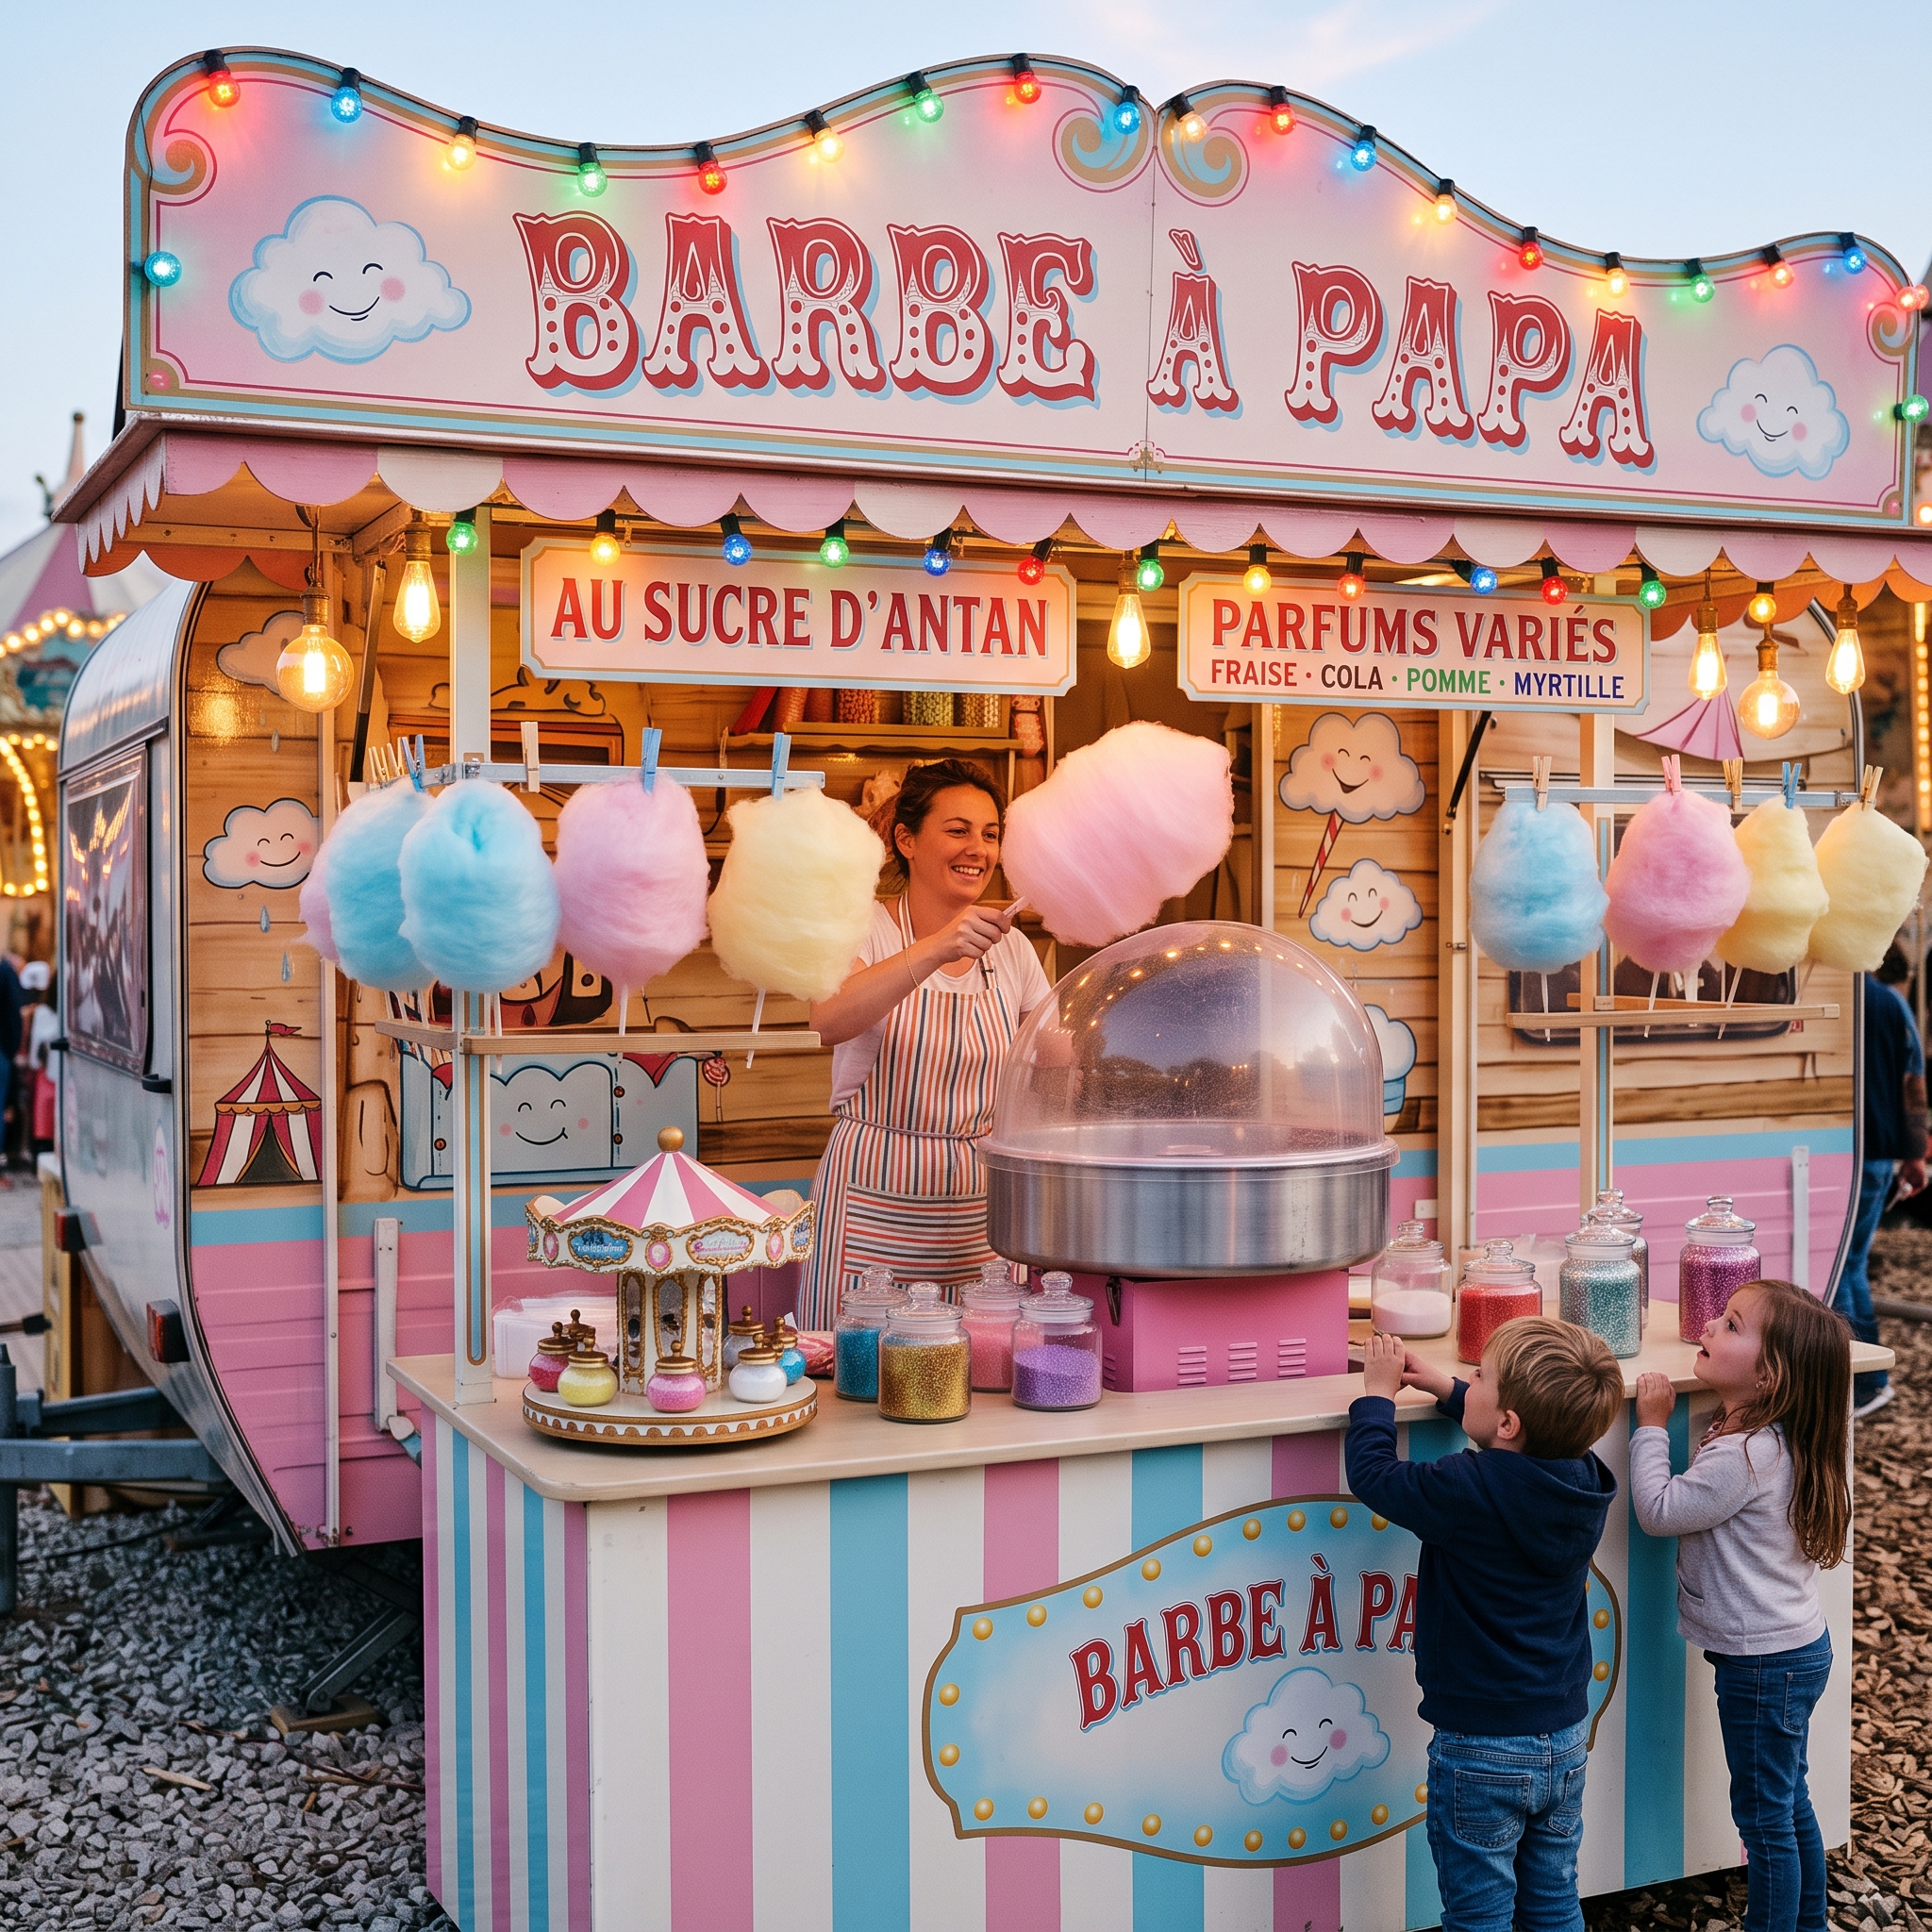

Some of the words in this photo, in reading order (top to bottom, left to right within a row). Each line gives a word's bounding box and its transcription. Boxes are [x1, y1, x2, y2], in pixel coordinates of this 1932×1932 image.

[512, 209, 1100, 408] BARBE
[1146, 228, 1242, 418] À
[1284, 260, 1657, 473] PAPA
[550, 577, 625, 641] AU
[643, 581, 812, 648] SUCRE
[1212, 599, 1438, 657] PARFUMS
[1454, 605, 1618, 664] VARIÉS
[1211, 659, 1297, 687] FRAISE
[1321, 664, 1383, 691] COLA
[1407, 668, 1491, 694] POMME
[1514, 673, 1624, 699] MYRTILLE
[1068, 1578, 1286, 1732] BARBE
[1299, 1553, 1342, 1655] À
[1355, 1571, 1417, 1655] PA
